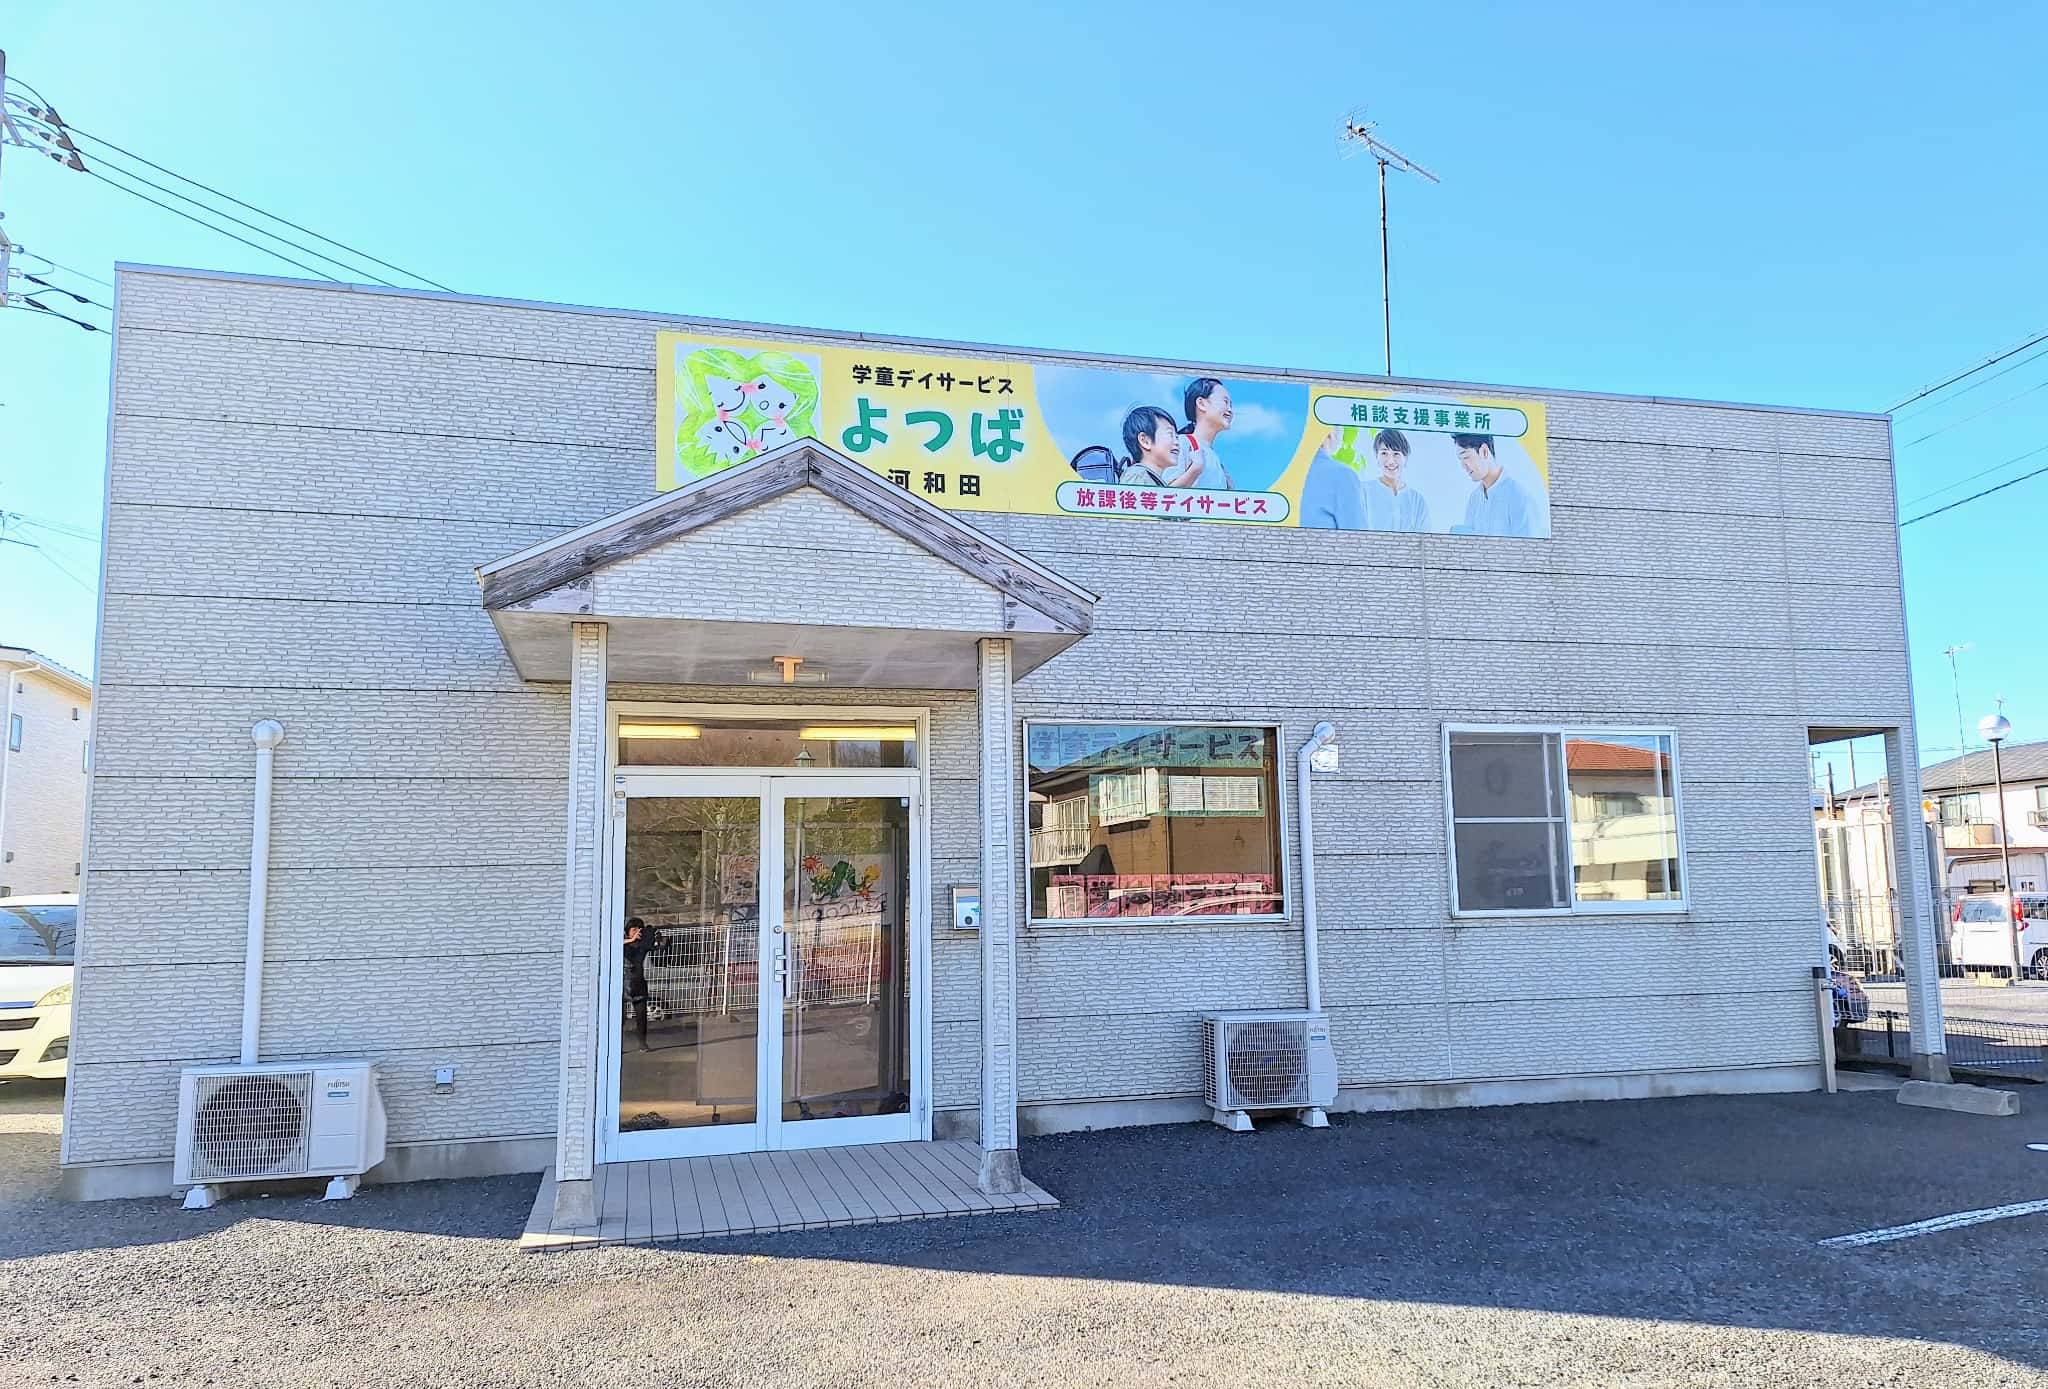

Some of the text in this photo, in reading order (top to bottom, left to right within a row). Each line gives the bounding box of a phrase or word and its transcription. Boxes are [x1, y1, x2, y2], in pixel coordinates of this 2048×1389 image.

[852, 364, 1014, 394] 学童デイサービス
[842, 397, 1025, 463] よつば
[1351, 403, 1491, 430] 相談支援事業所
[887, 468, 981, 497] 河和田
[1076, 487, 1268, 515] 放課後等デイサービス
